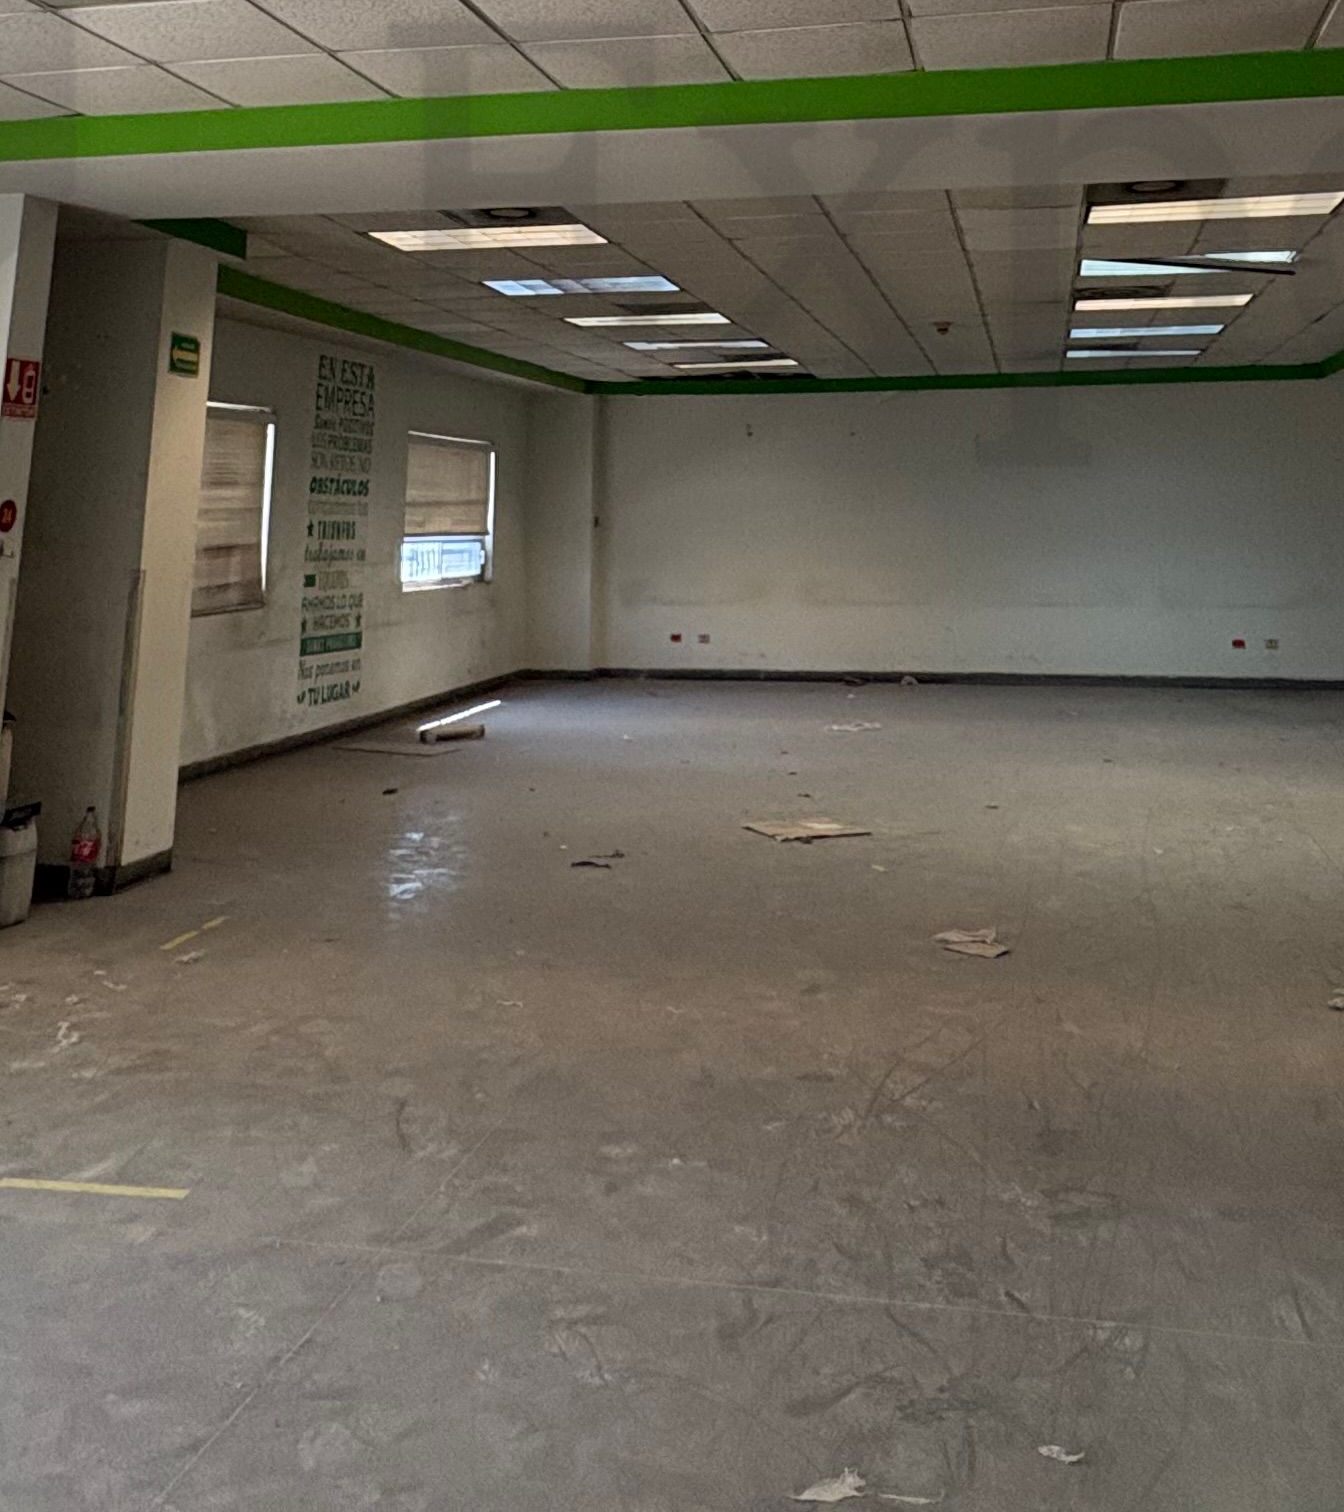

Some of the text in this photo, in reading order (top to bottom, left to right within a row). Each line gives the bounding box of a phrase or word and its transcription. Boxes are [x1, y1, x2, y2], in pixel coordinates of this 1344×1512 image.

[317, 354, 376, 391] EN ESTA
[315, 382, 376, 422] EMPRESA
[309, 473, 370, 497] OBSTÁCULOS
[307, 680, 351, 707] TU LUGAR
